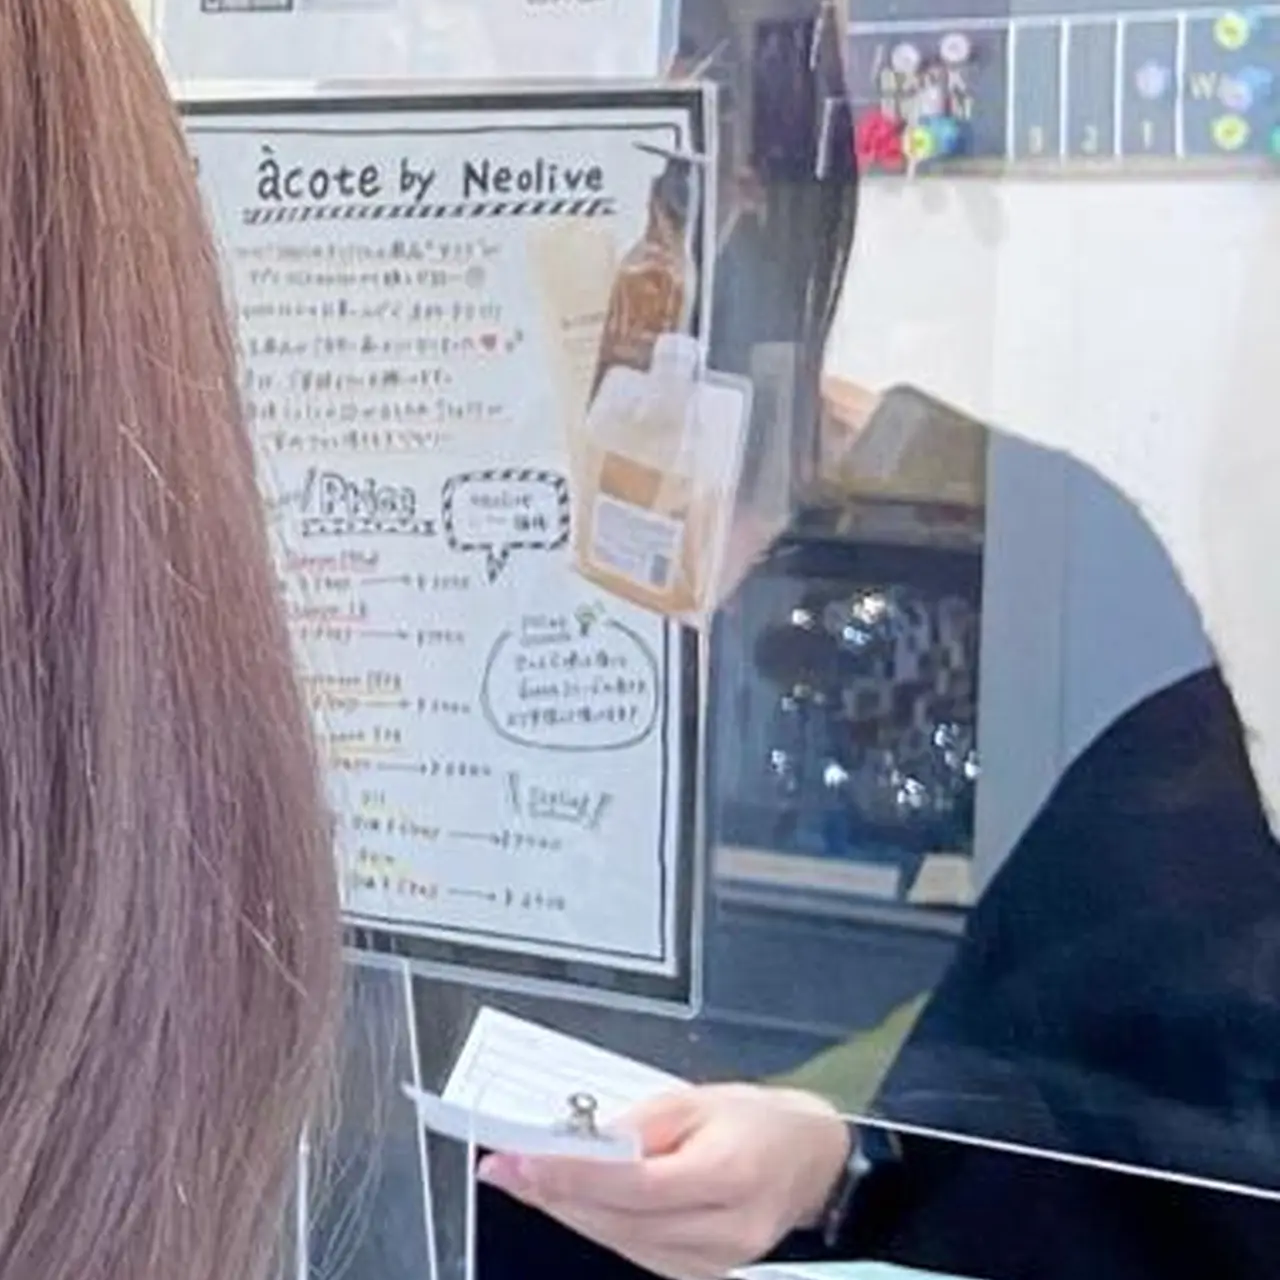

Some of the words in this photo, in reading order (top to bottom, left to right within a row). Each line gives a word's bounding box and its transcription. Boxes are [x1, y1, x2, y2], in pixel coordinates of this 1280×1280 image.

[257, 145, 382, 201] àcote
[400, 156, 437, 203] by
[462, 157, 605, 198] Neolive
